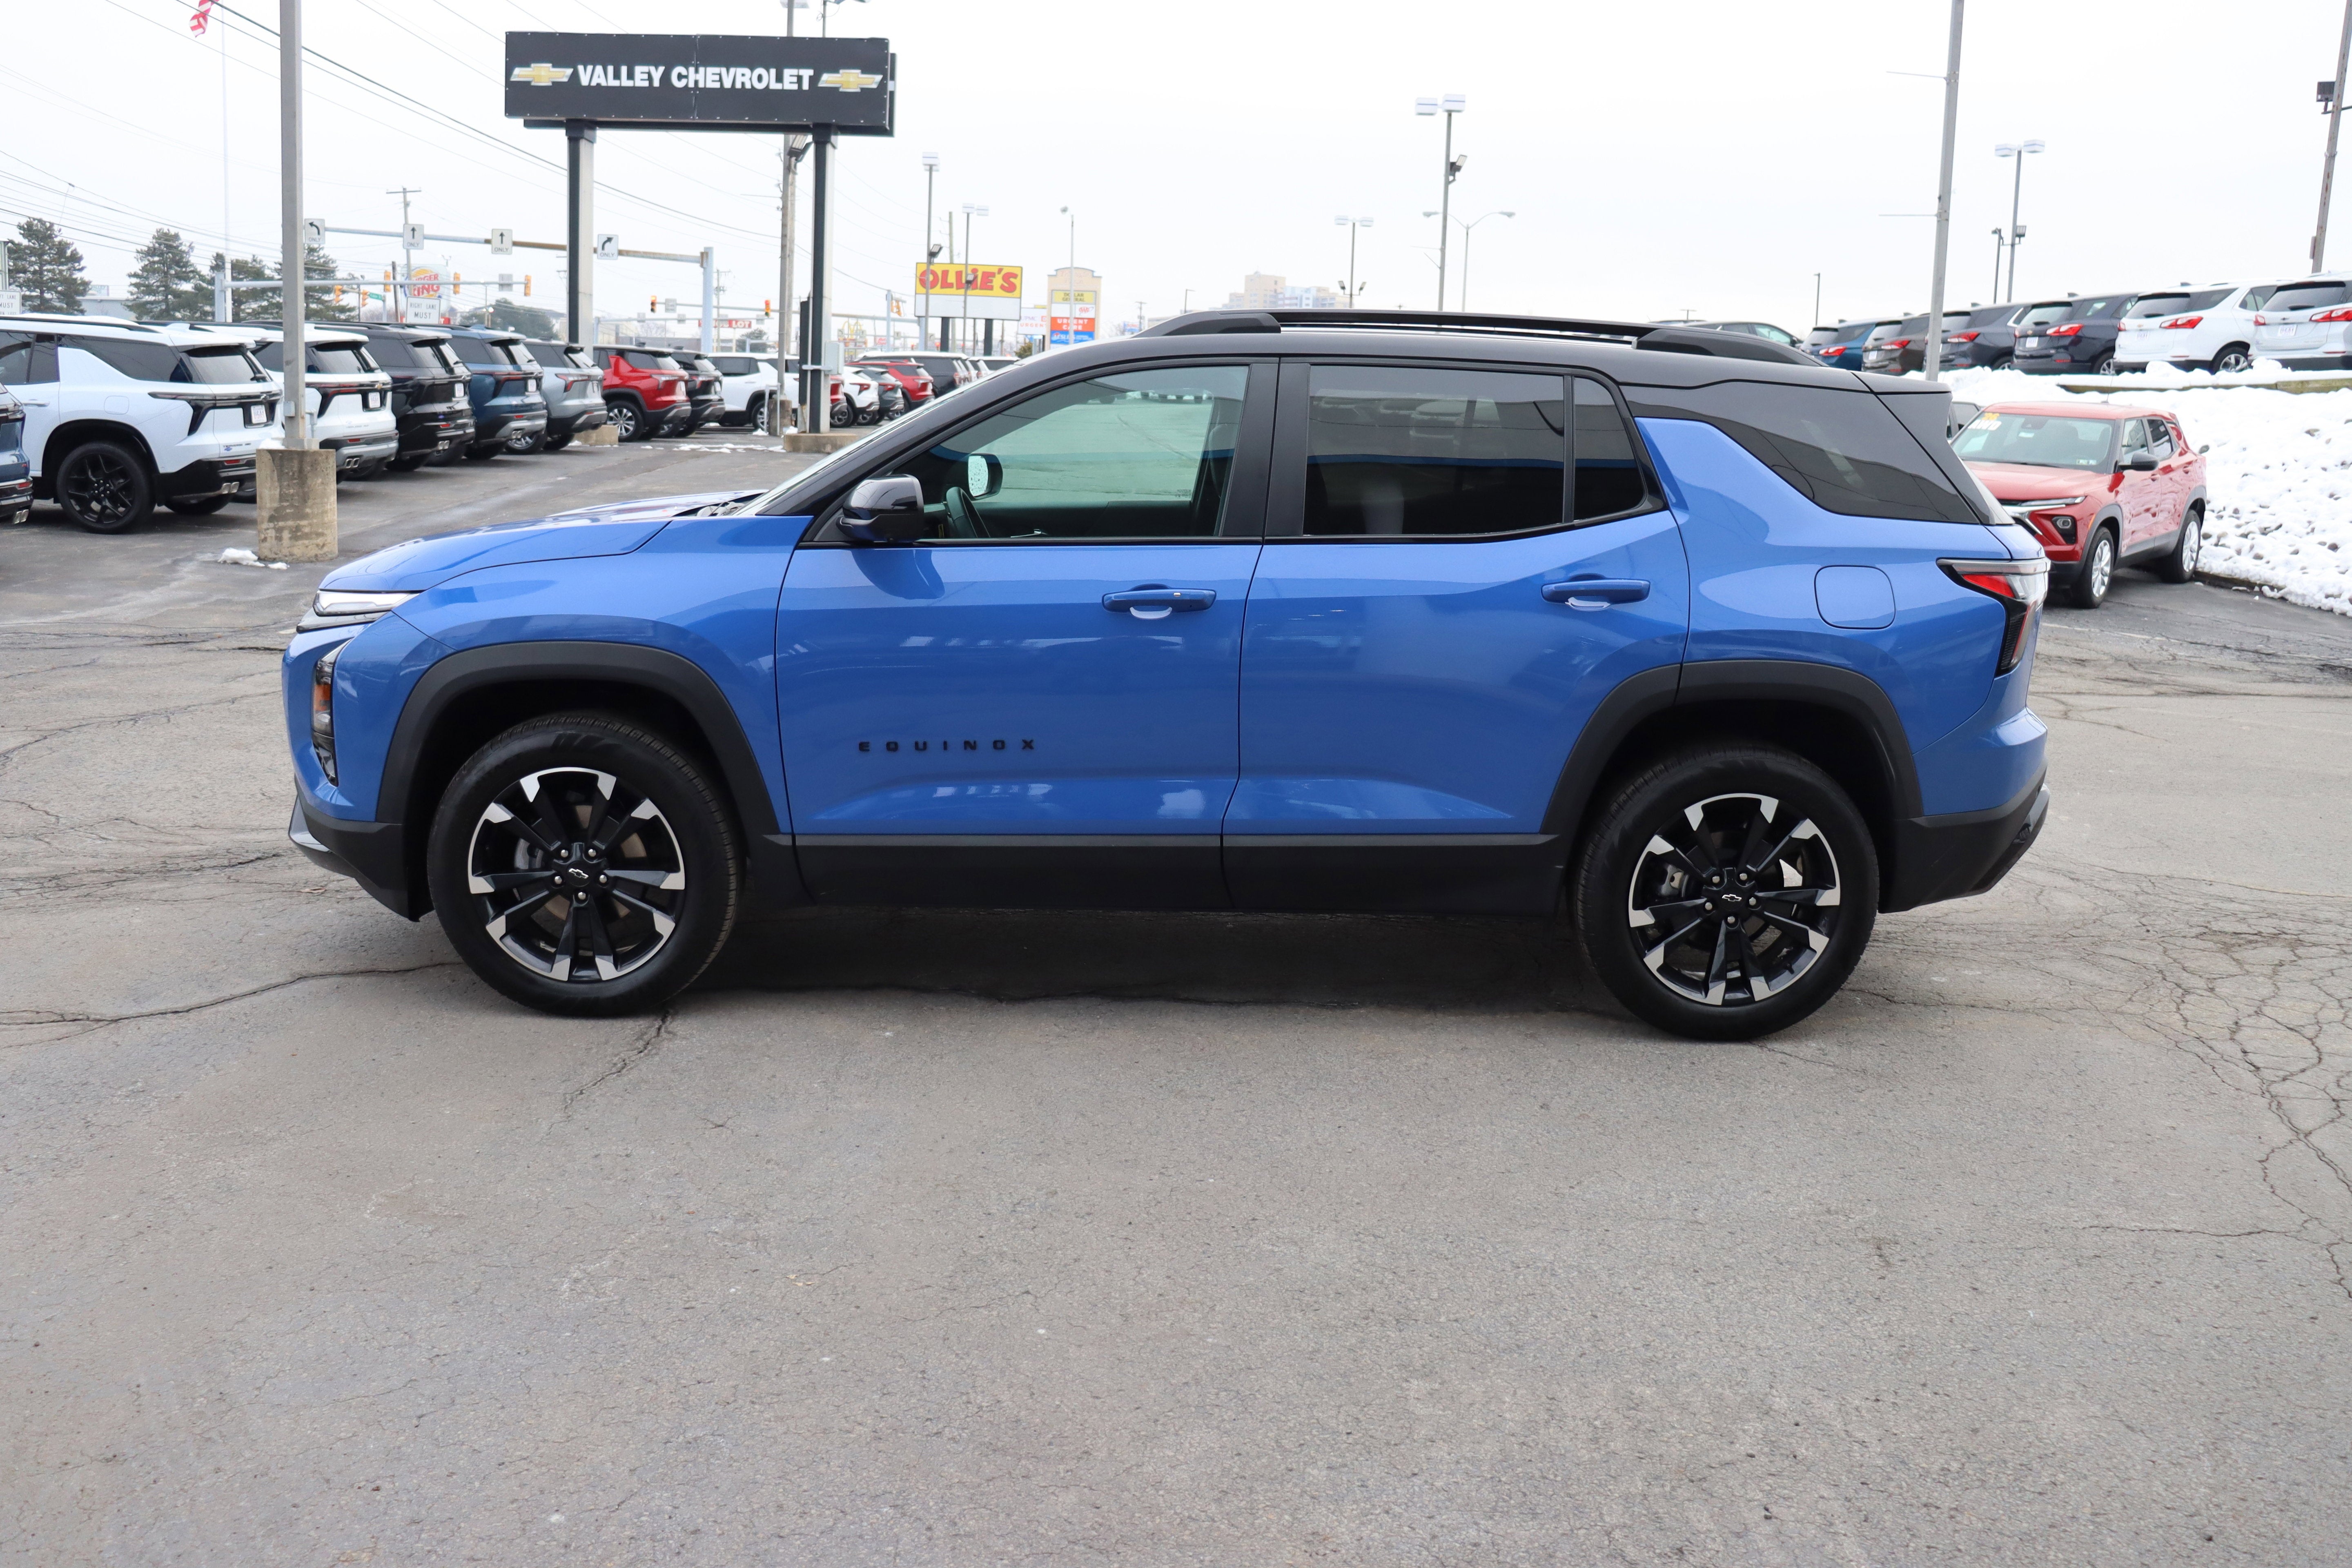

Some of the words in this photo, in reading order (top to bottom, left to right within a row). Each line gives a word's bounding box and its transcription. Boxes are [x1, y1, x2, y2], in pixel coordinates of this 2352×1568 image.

[577, 65, 665, 87] VALLEY
[671, 66, 814, 90] CHEVROLET
[1967, 419, 2002, 430] AWD
[858, 739, 1034, 752] EQUINOX
